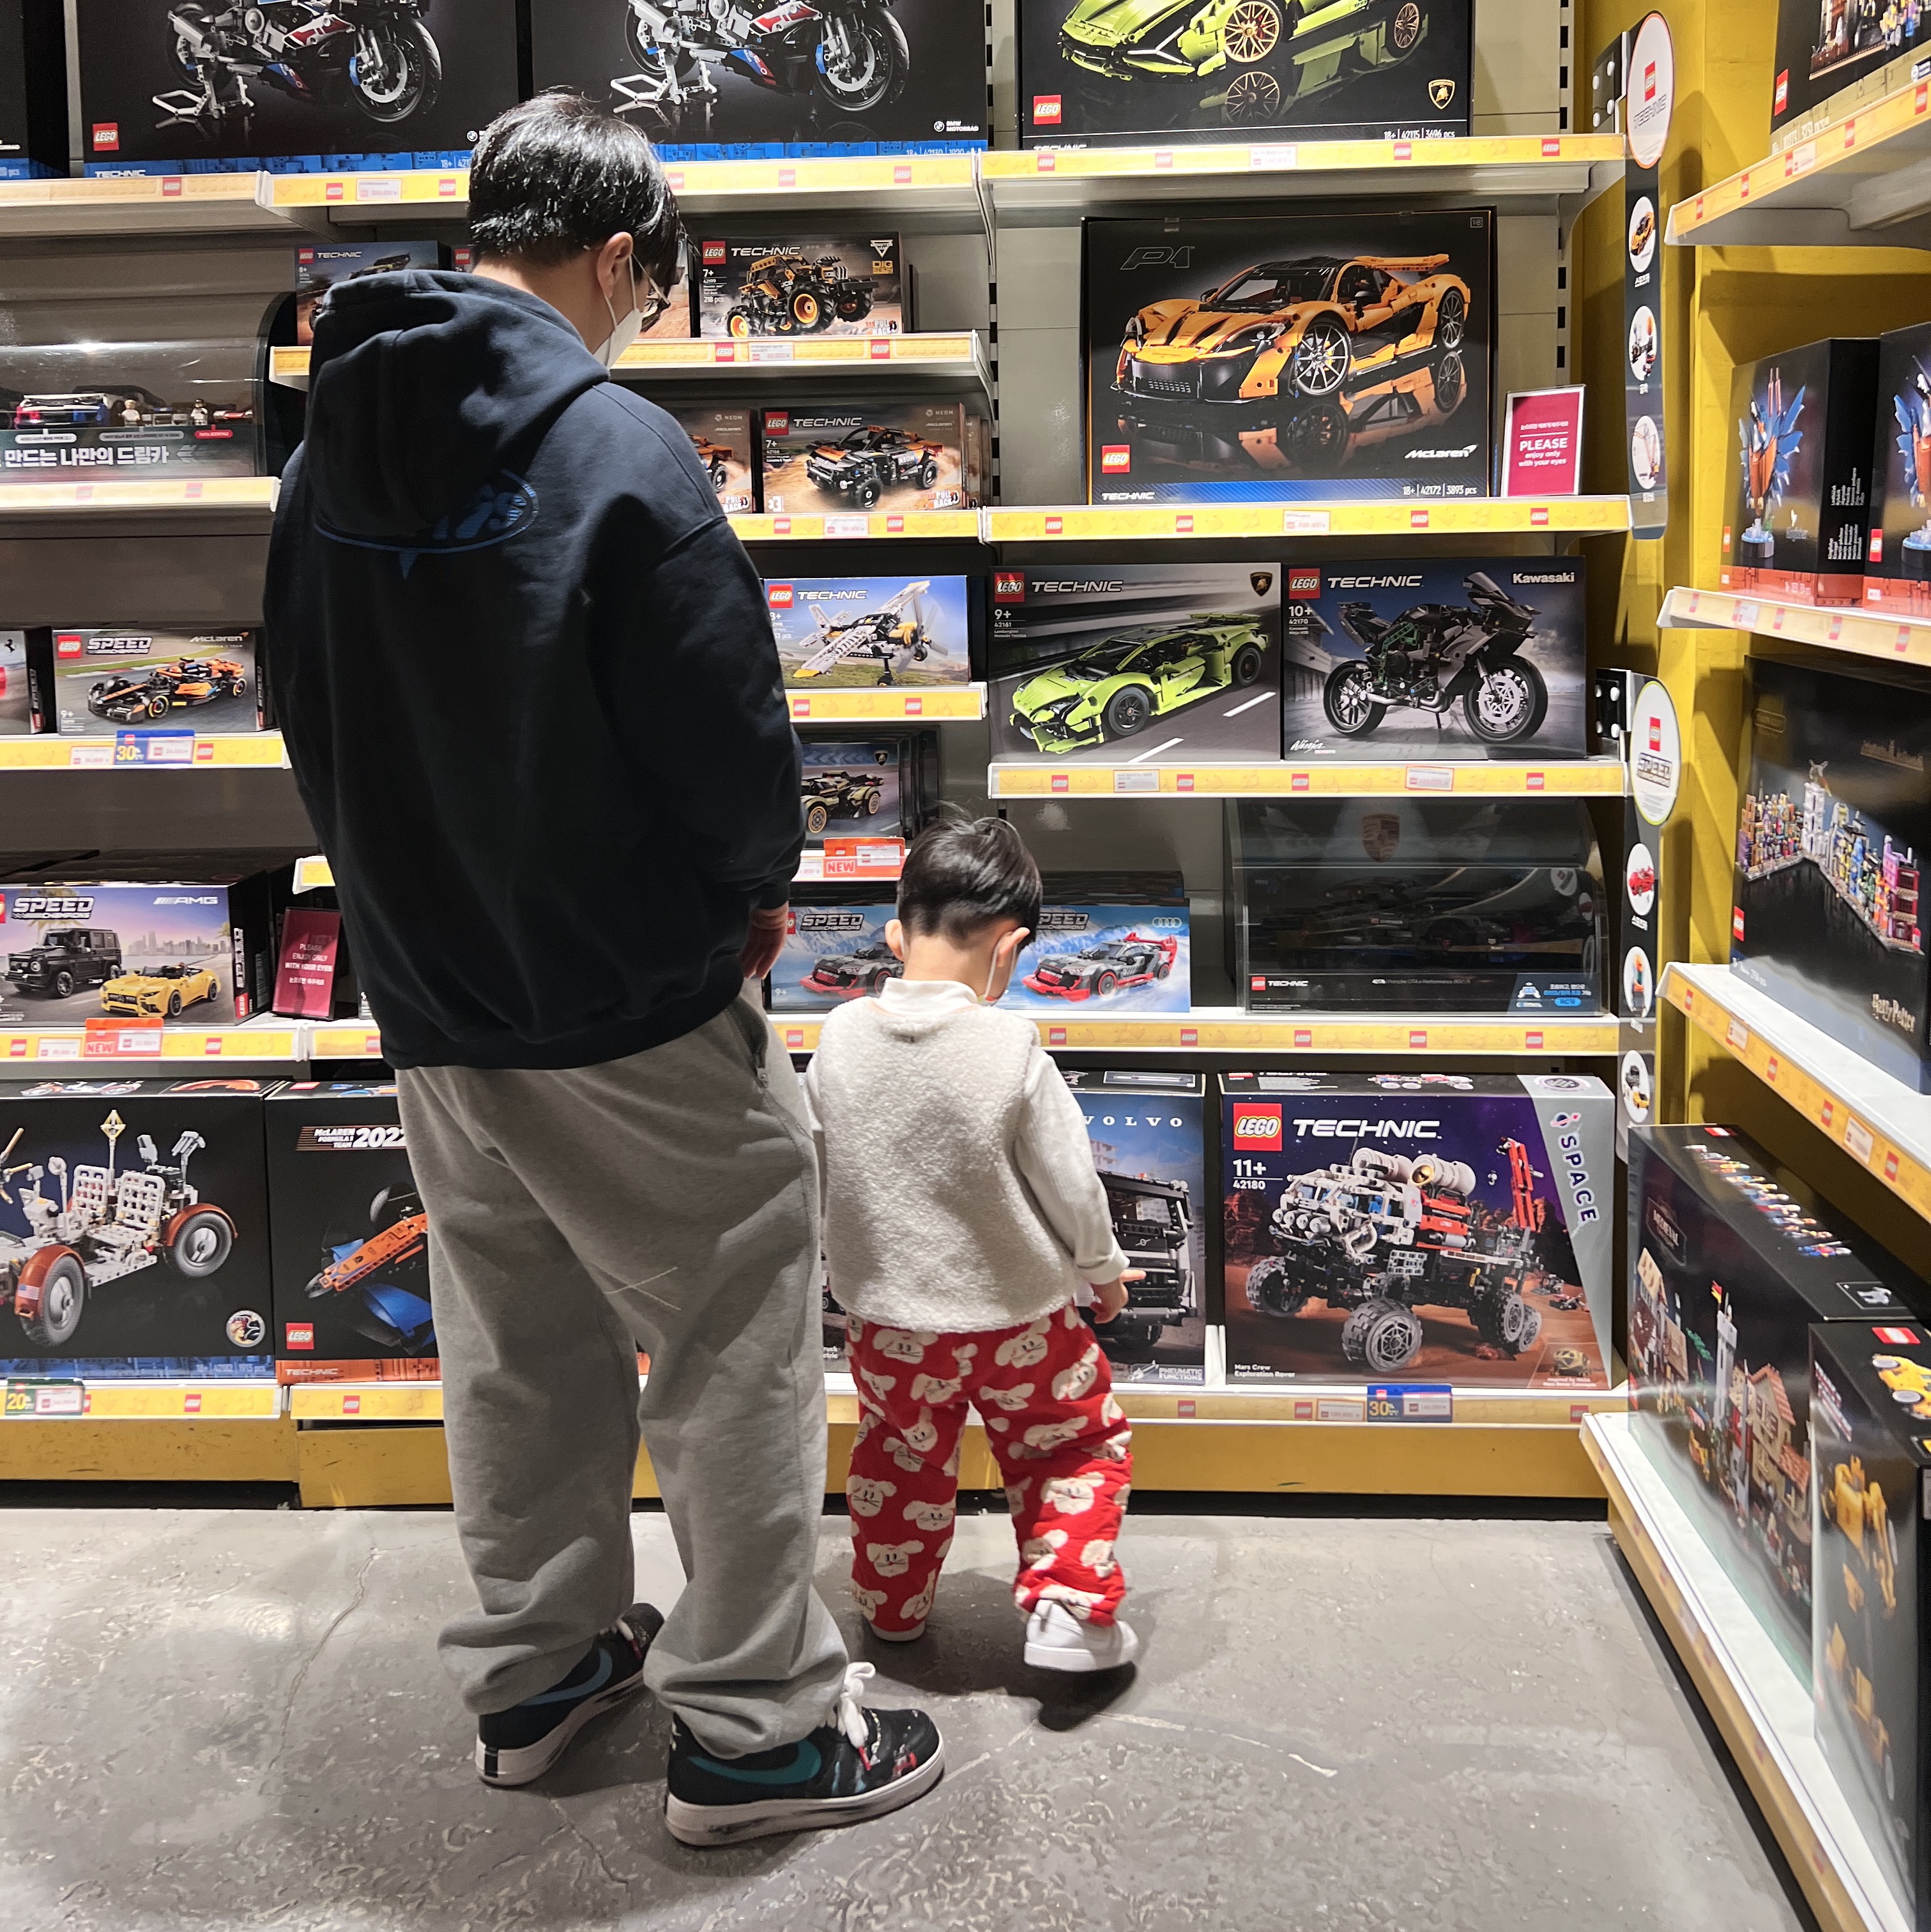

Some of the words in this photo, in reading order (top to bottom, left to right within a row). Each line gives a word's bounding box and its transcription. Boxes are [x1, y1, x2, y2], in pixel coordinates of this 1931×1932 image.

[1035, 103, 1059, 116] LEGO
[96, 131, 116, 142] LEGO
[1384, 131, 1396, 140] 18+
[1401, 130, 1421, 139] 42115
[1425, 129, 1442, 139] 3696
[441, 160, 453, 168] 18+
[95, 169, 146, 178] TECHNIC
[705, 248, 724, 257] LEGO
[731, 247, 801, 256] TECHNIC
[703, 268, 714, 278] 7+
[716, 347, 733, 356] LEGO
[767, 419, 787, 428] LEGO
[793, 417, 862, 427] TECHNIC
[766, 439, 777, 448] 7+
[1520, 437, 1568, 451] PLEASE
[4, 449, 57, 468] 만드는
[60, 447, 114, 466] 나만의
[117, 446, 170, 465] 드림카
[1103, 452, 1129, 466] LEGO
[1405, 448, 1469, 459] McLaren
[1101, 492, 1156, 501] TECHNIC
[1403, 486, 1415, 496] 18+
[1421, 485, 1442, 495] 42172
[1446, 485, 1463, 496] 3893
[1464, 487, 1477, 497] pcs
[1532, 512, 1548, 521] LEGO
[1291, 577, 1318, 589] LEGO
[1327, 575, 1423, 588] TECHNIC
[1513, 572, 1575, 584] Kawasaki
[996, 581, 1023, 593] LEGO
[1032, 581, 1124, 593] TECHNIC
[771, 591, 791, 601] LEGO
[797, 590, 868, 600] TECHNIC
[994, 609, 1012, 620] 9+
[1288, 605, 1313, 617] 10+
[88, 637, 153, 650] SPEED
[1290, 739, 1326, 754] Ninja
[828, 862, 854, 872] NEW
[13, 897, 95, 912] SPEED
[174, 896, 218, 904] AMG
[802, 914, 864, 926] SPEED
[1039, 913, 1088, 925] PEED
[774, 987, 788, 996] 9+
[87, 1041, 113, 1054] NEW
[1236, 1115, 1279, 1137] LEGO
[1293, 1119, 1440, 1137] TECHNIC
[1233, 1159, 1267, 1176] 11+
[1560, 1135, 1598, 1222] SPACE
[1233, 1179, 1266, 1190] 42180
[288, 1330, 312, 1341] LEGO
[1295, 1406, 1311, 1415] LEGO
